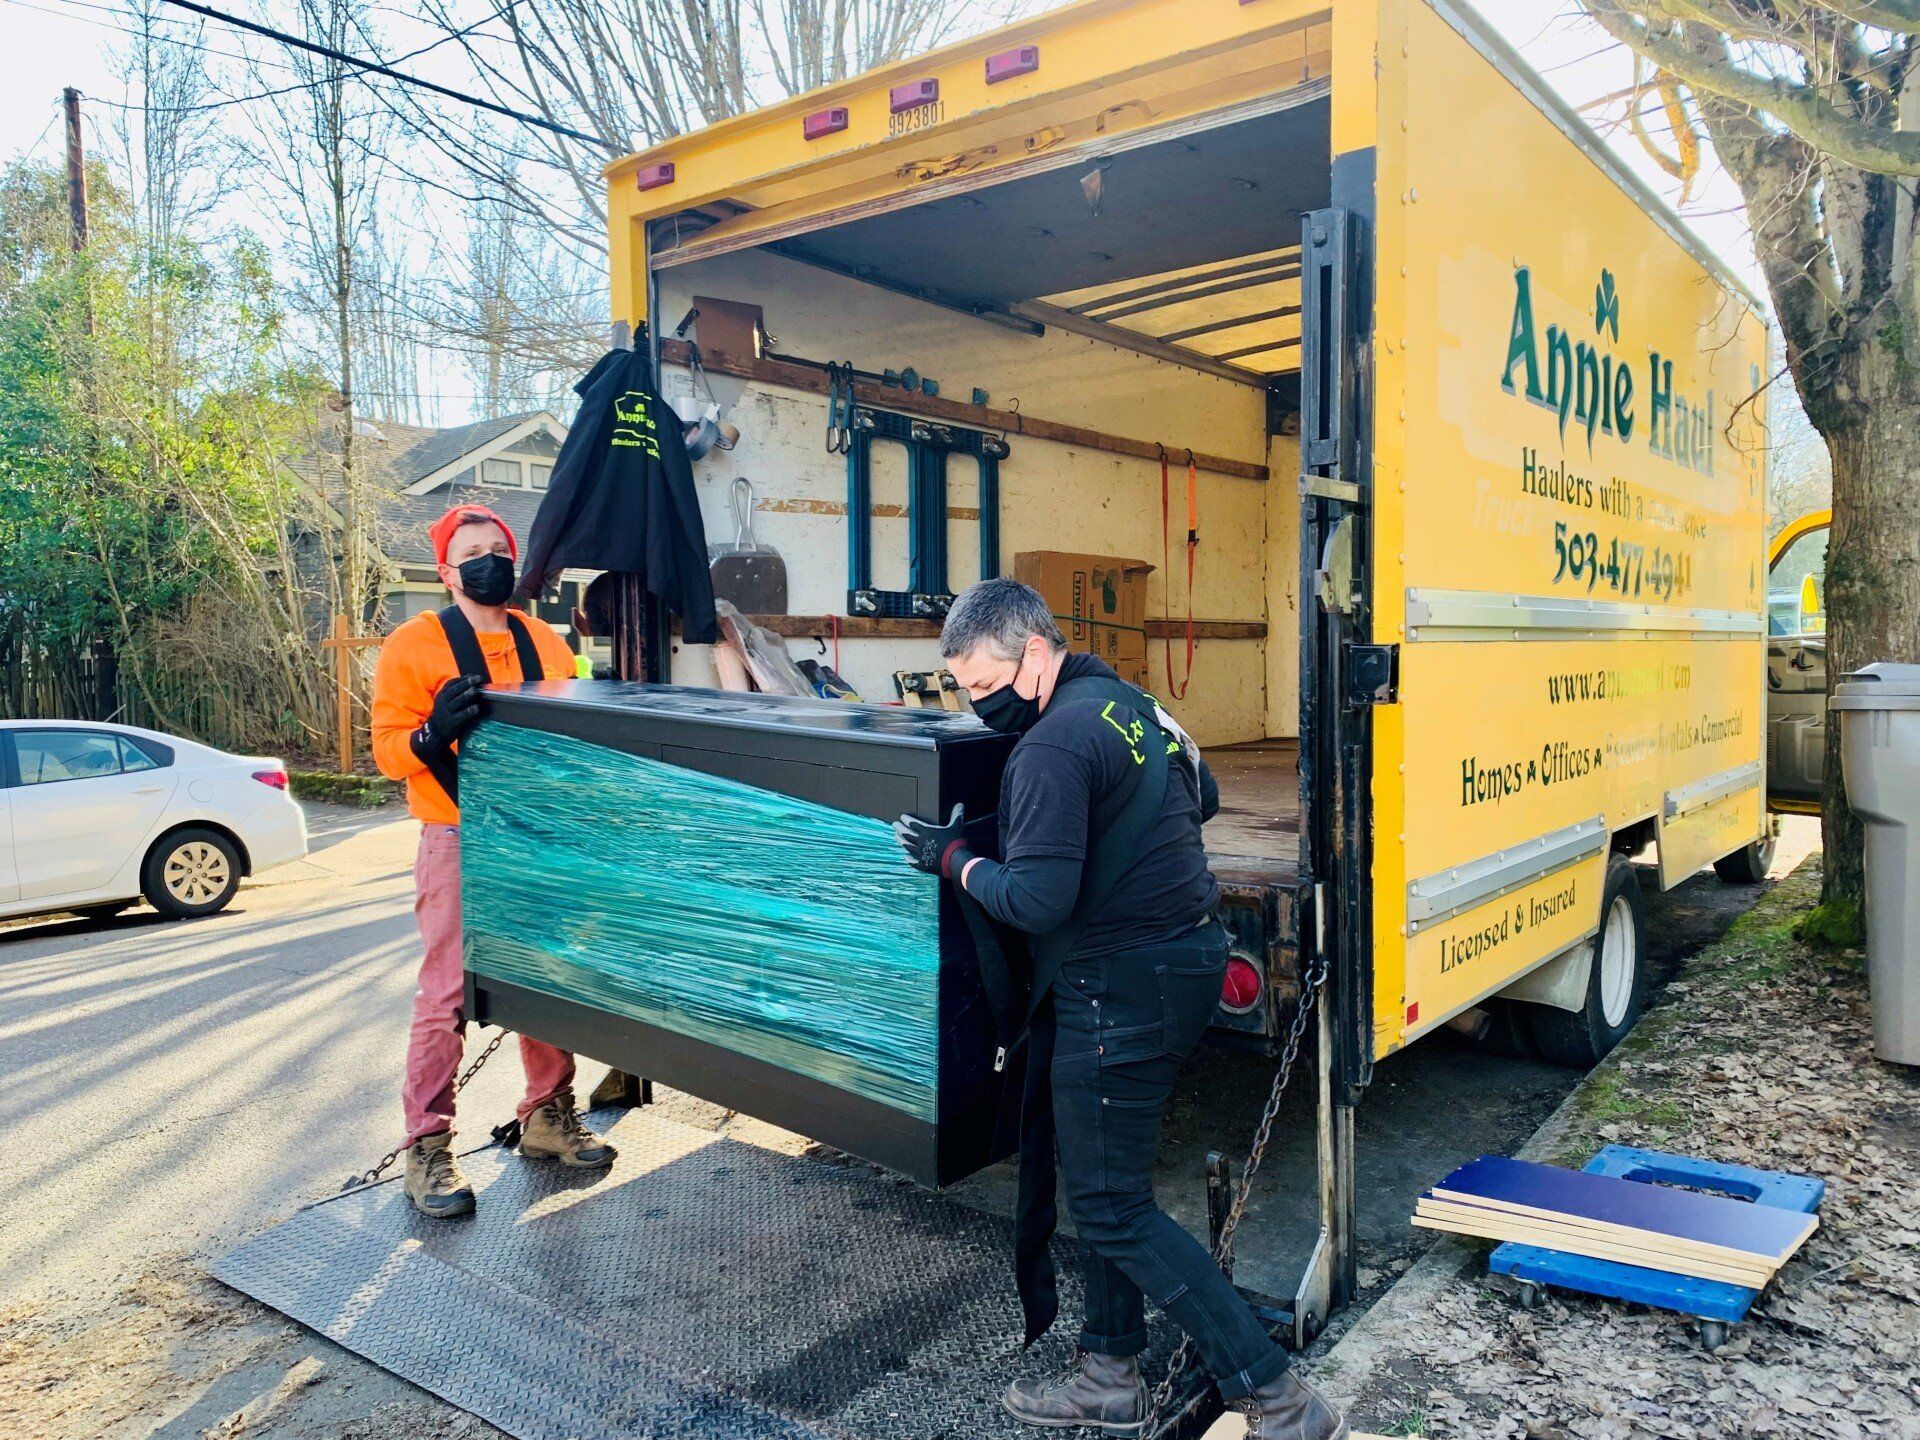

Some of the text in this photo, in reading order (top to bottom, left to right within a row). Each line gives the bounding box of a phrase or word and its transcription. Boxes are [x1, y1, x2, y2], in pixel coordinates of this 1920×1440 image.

[889, 99, 945, 136] 9923801
[1500, 265, 1714, 479] Annie Haul
[617, 411, 646, 424] Anni
[1522, 446, 1593, 509] Haulers
[1600, 476, 1631, 525] with
[1461, 756, 1522, 807] Homes
[1541, 741, 1590, 787] Offices
[1701, 709, 1743, 745] Commercial
[1440, 879, 1576, 974] Licensed & Insured
